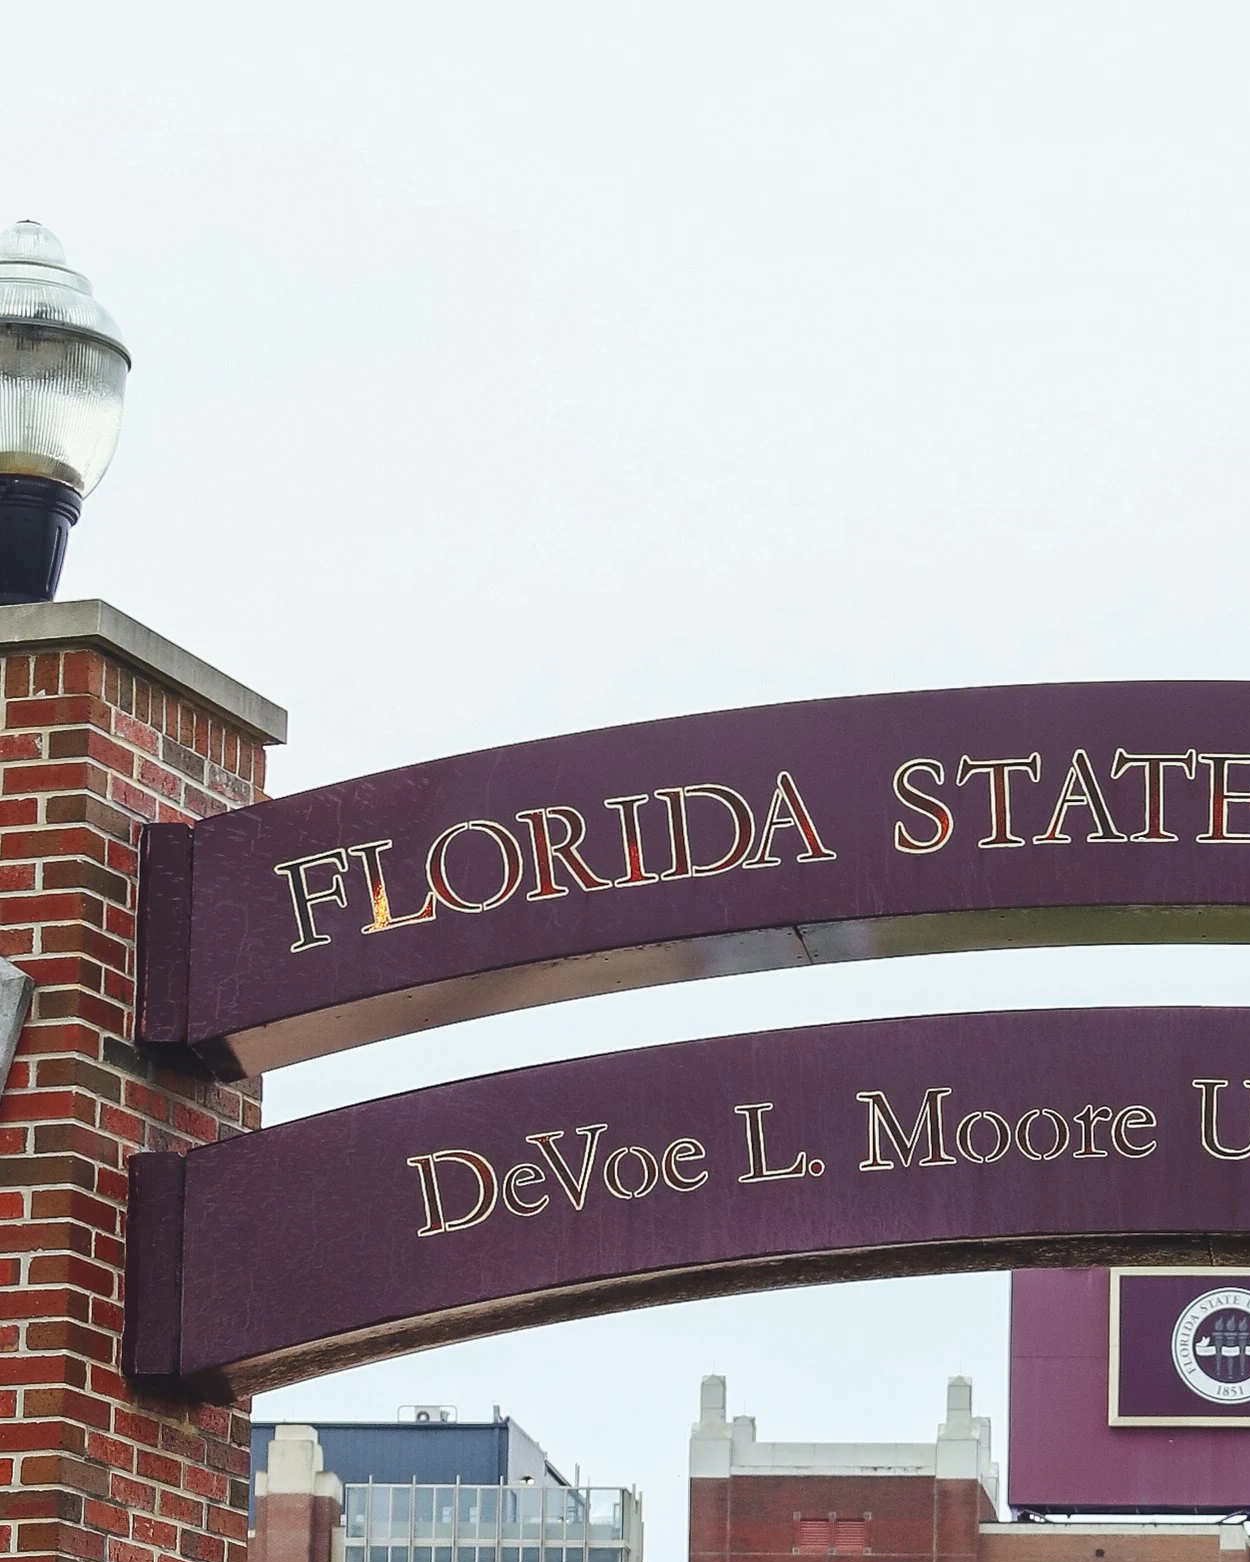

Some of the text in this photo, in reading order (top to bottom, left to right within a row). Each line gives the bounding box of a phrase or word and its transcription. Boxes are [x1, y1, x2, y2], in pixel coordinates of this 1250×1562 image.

[274, 770, 837, 953] FLORIDA
[406, 1123, 709, 1237] DeVoe
[734, 1102, 826, 1183] L.
[856, 1087, 1157, 1172] Moore
[1180, 1313, 1200, 1375] FLORIDA
[1199, 1295, 1241, 1313] STATE
[1216, 1385, 1245, 1397] 1851
